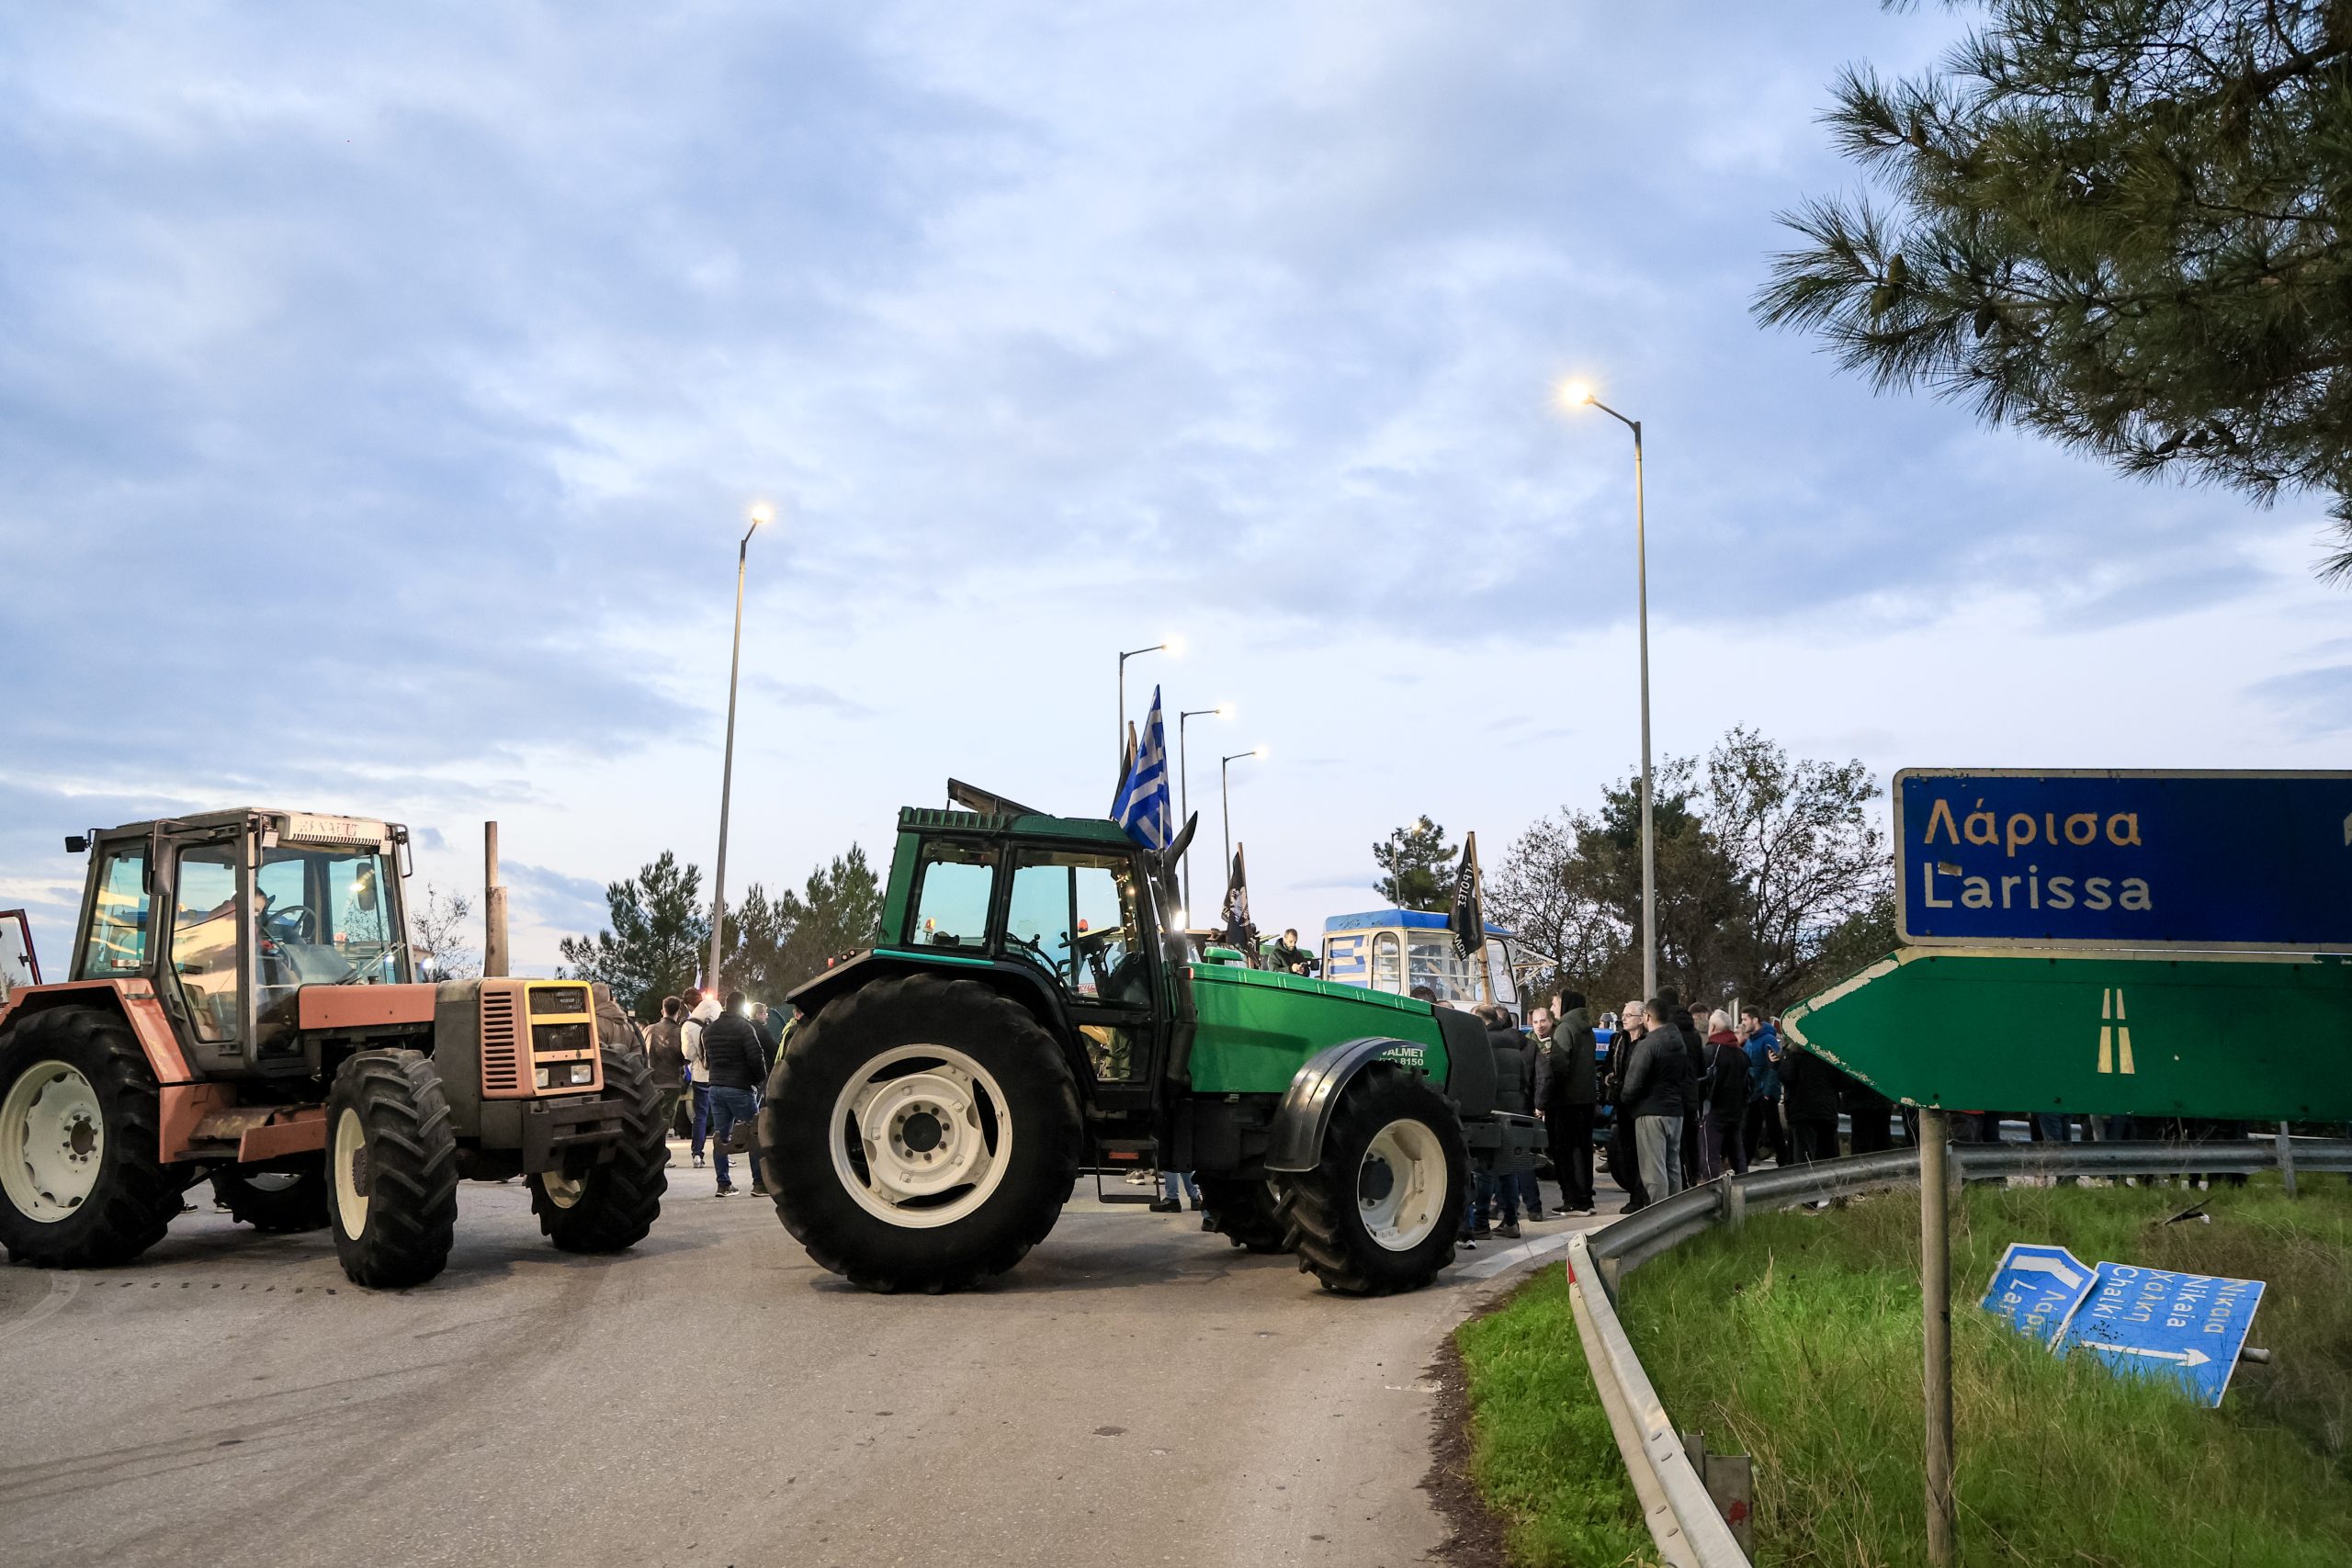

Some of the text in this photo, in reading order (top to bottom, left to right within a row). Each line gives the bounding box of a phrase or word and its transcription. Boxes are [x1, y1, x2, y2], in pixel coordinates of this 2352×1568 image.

[1924, 798, 2142, 857] Λάρισα
[1924, 862, 2153, 910] Larissa
[1400, 1057, 1423, 1066] 8150
[2091, 1266, 2141, 1320] Chalki
[2123, 1269, 2177, 1323] Χάλκη
[2165, 1275, 2212, 1328] Nikaia
[2203, 1279, 2251, 1334] Νίκαια
